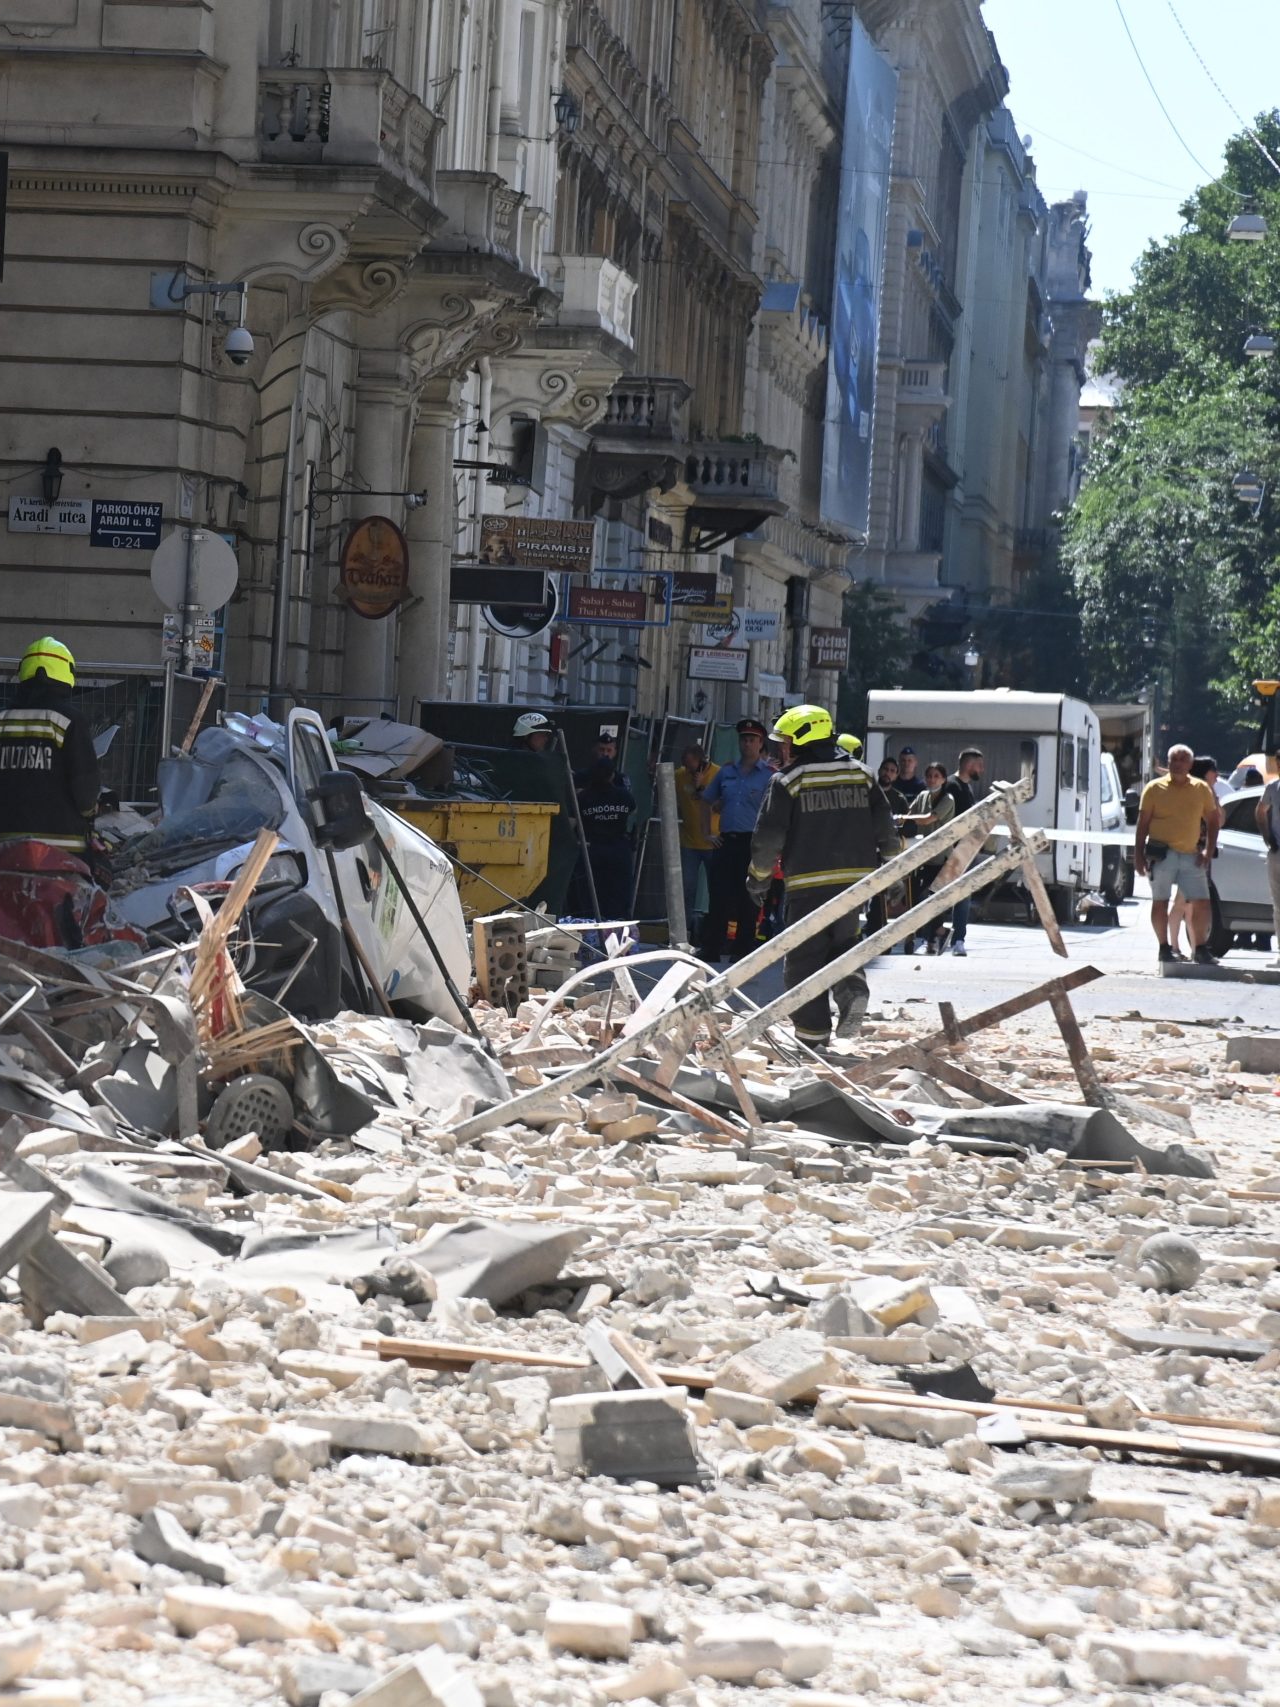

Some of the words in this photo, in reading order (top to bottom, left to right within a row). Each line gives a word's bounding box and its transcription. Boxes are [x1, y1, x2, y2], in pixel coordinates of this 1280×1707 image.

[13, 507, 49, 522] Aradi
[59, 513, 86, 524] utca
[95, 503, 160, 516] PARKOLÓHÁZ
[99, 515, 130, 526] ARADI
[133, 518, 142, 527] u.
[145, 517, 155, 527] 8.
[112, 536, 141, 549] 0-24
[517, 542, 576, 553] PIRAMIS
[580, 596, 604, 605] Sabai
[611, 598, 636, 607] Sabai
[578, 607, 597, 616] Thai
[599, 609, 637, 619] Massage
[745, 619, 776, 627] HANGHAI
[811, 634, 847, 648] Cactus
[816, 648, 846, 665] Juice
[800, 785, 869, 813] TŰZOLTÓSÁG
[498, 818, 516, 838] 63
